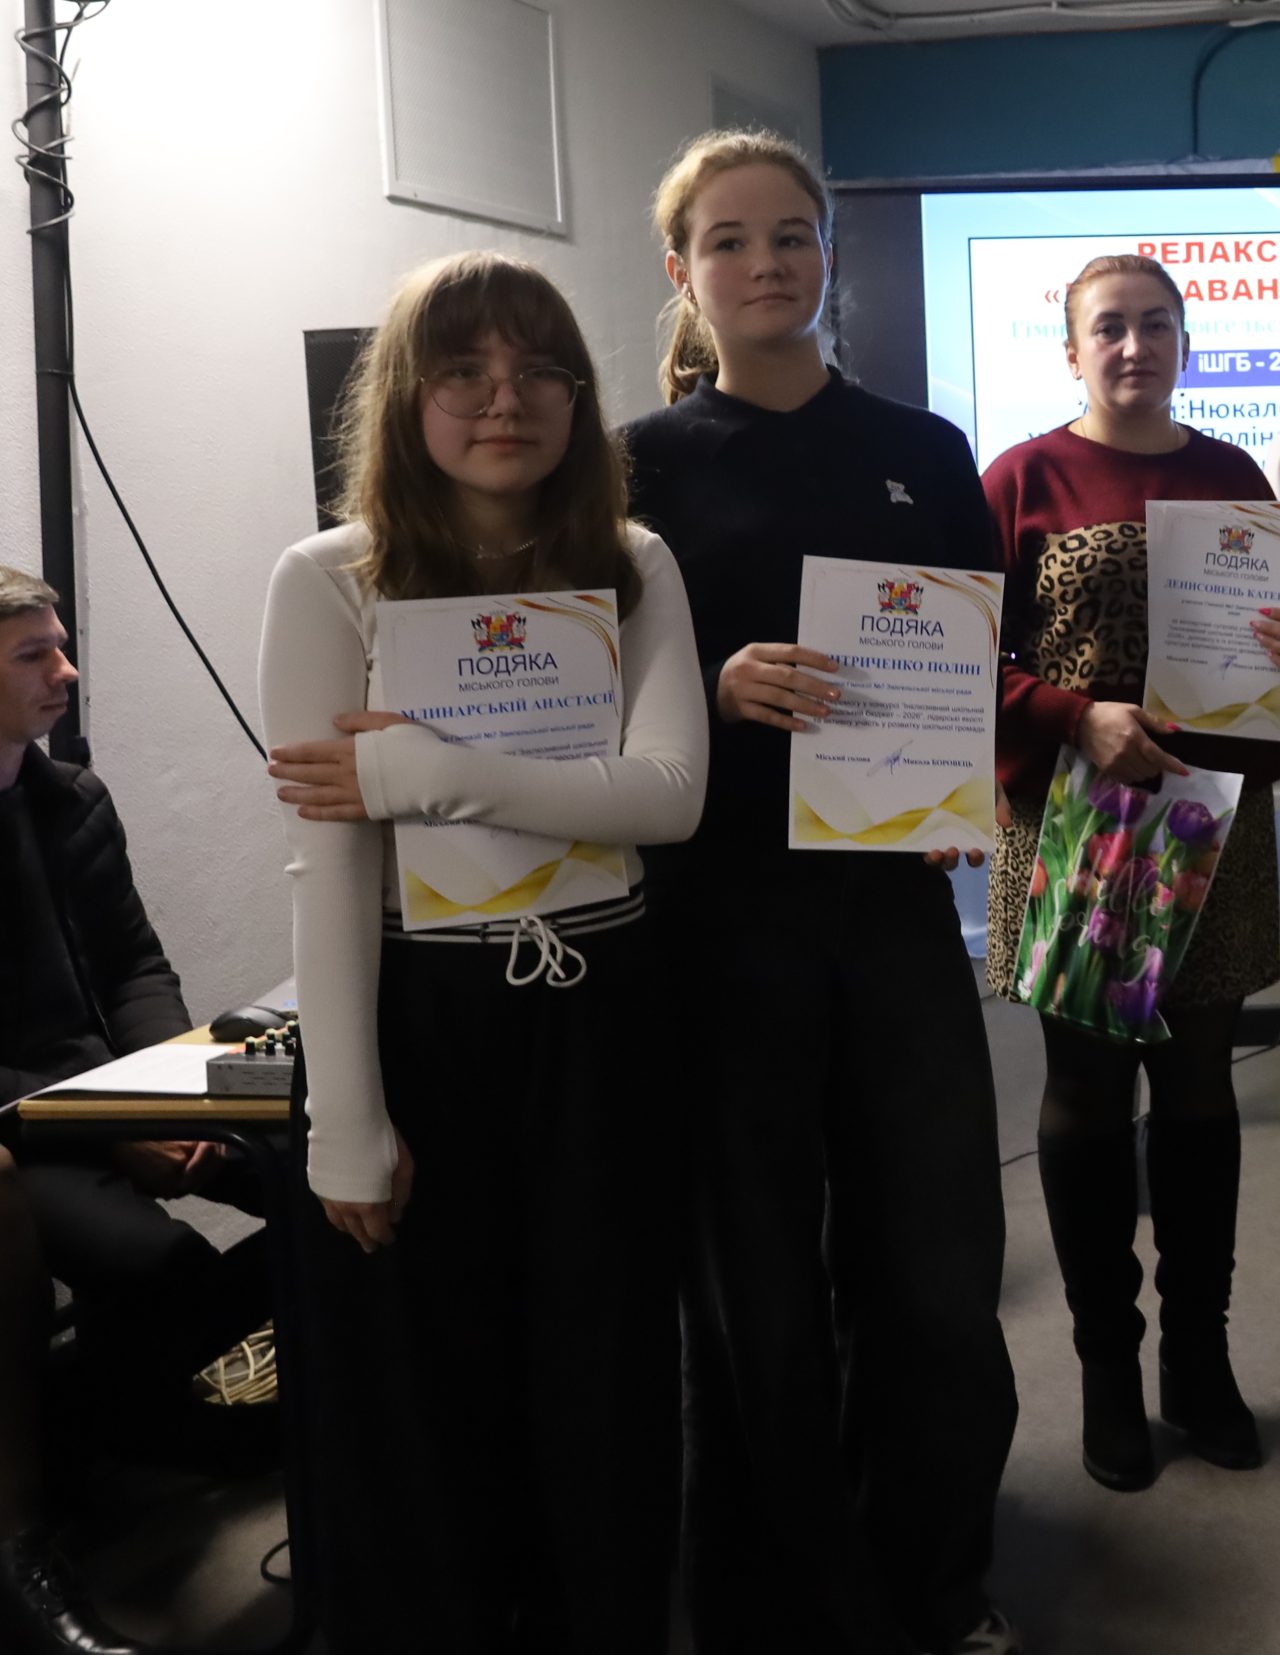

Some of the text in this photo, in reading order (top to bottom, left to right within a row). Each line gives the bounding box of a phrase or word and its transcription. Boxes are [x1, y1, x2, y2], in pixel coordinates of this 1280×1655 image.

[1137, 240, 1277, 264] РЕЛАКС
[1198, 352, 1251, 373] іШГБ
[1199, 425, 1274, 447] Полін
[1205, 552, 1270, 572] ПОДЯКА
[860, 614, 945, 637] ПОДЯКА
[859, 636, 944, 651] МІСЬКОГО ГОЛОВИ
[458, 652, 558, 678] ПОДЯКА
[828, 653, 981, 676] ИТРИЧЕНКО ПОЛІНІ
[458, 676, 559, 693] МІСЬКОГО ГОЛОВИ
[401, 690, 614, 721] МЛИНАРСЬКІЙ АНАСТАСІЇ
